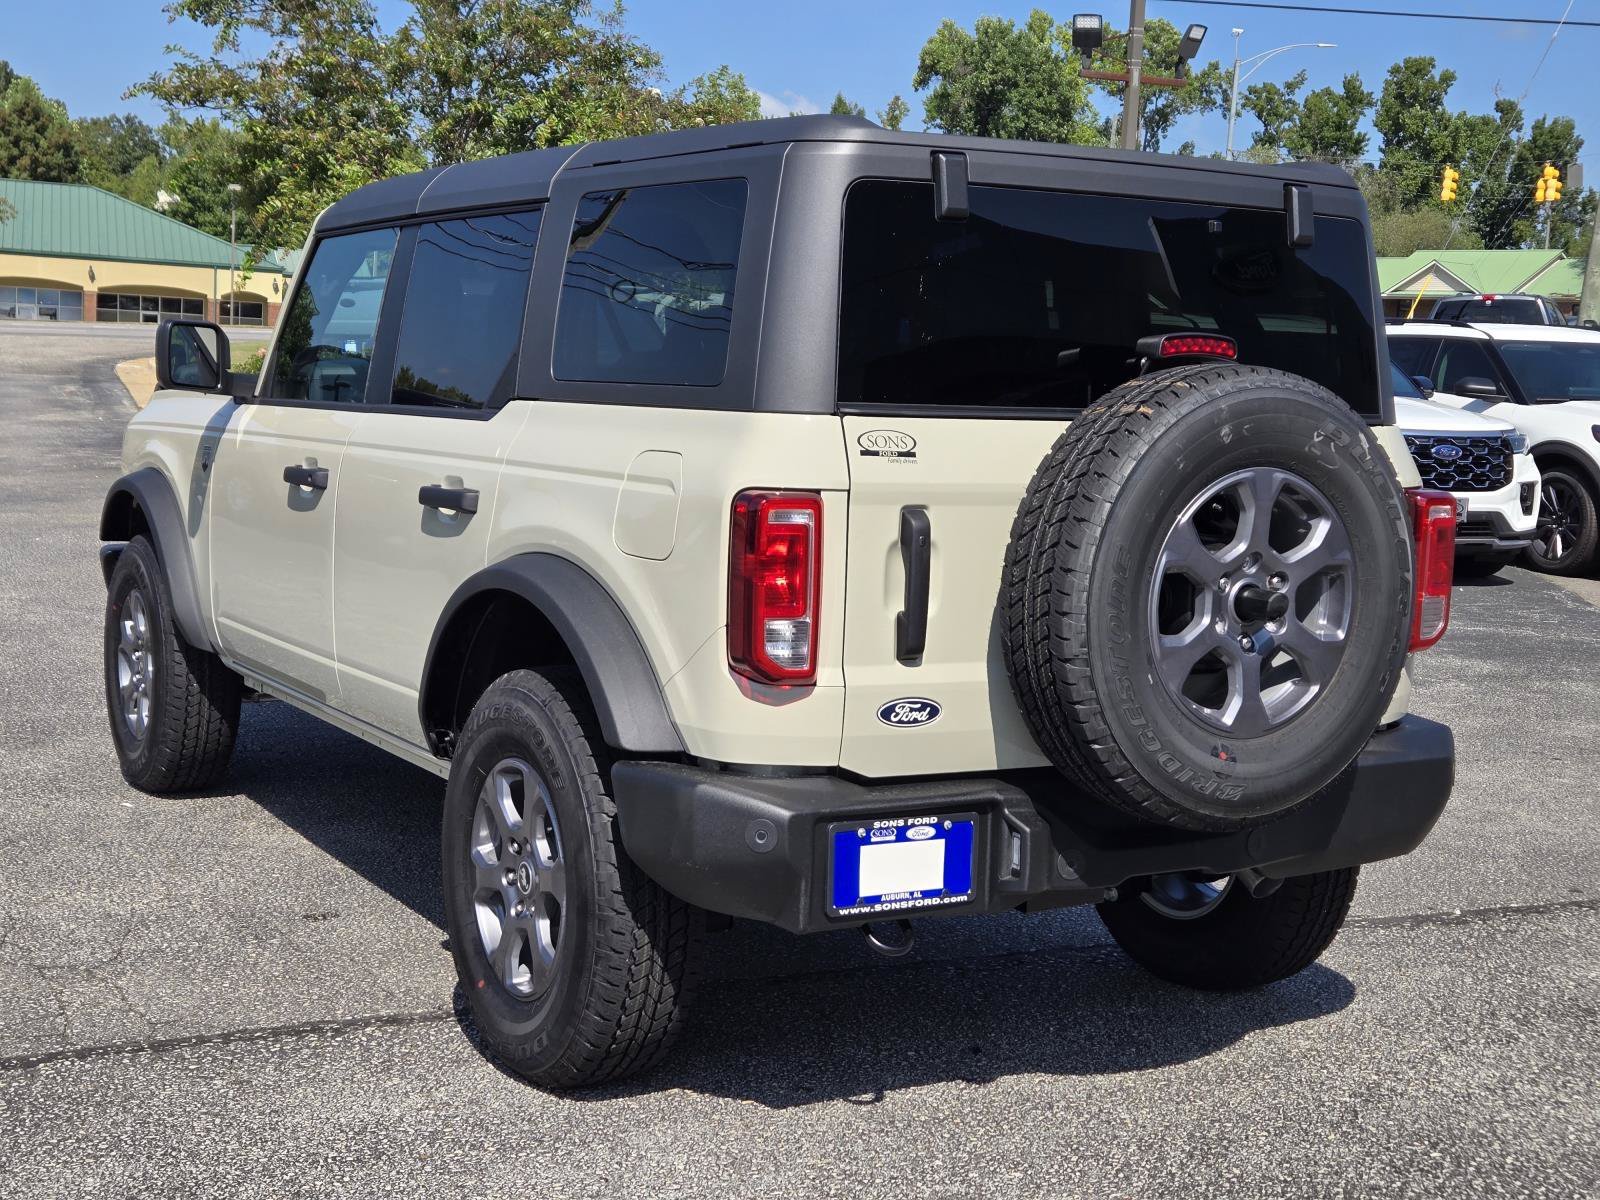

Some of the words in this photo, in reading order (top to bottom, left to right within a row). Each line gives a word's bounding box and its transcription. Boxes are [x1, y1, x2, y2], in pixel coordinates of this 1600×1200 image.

[866, 434, 908, 449] SONS
[1107, 544, 1248, 801] BRIDGESTONE
[890, 703, 931, 721] Ford
[873, 819, 905, 828] SONS
[907, 816, 938, 826] FORD
[874, 829, 893, 838] SONS
[881, 891, 912, 901] AUBURN,
[913, 890, 922, 898] AL
[839, 895, 968, 915] www.SONSFORD.com
